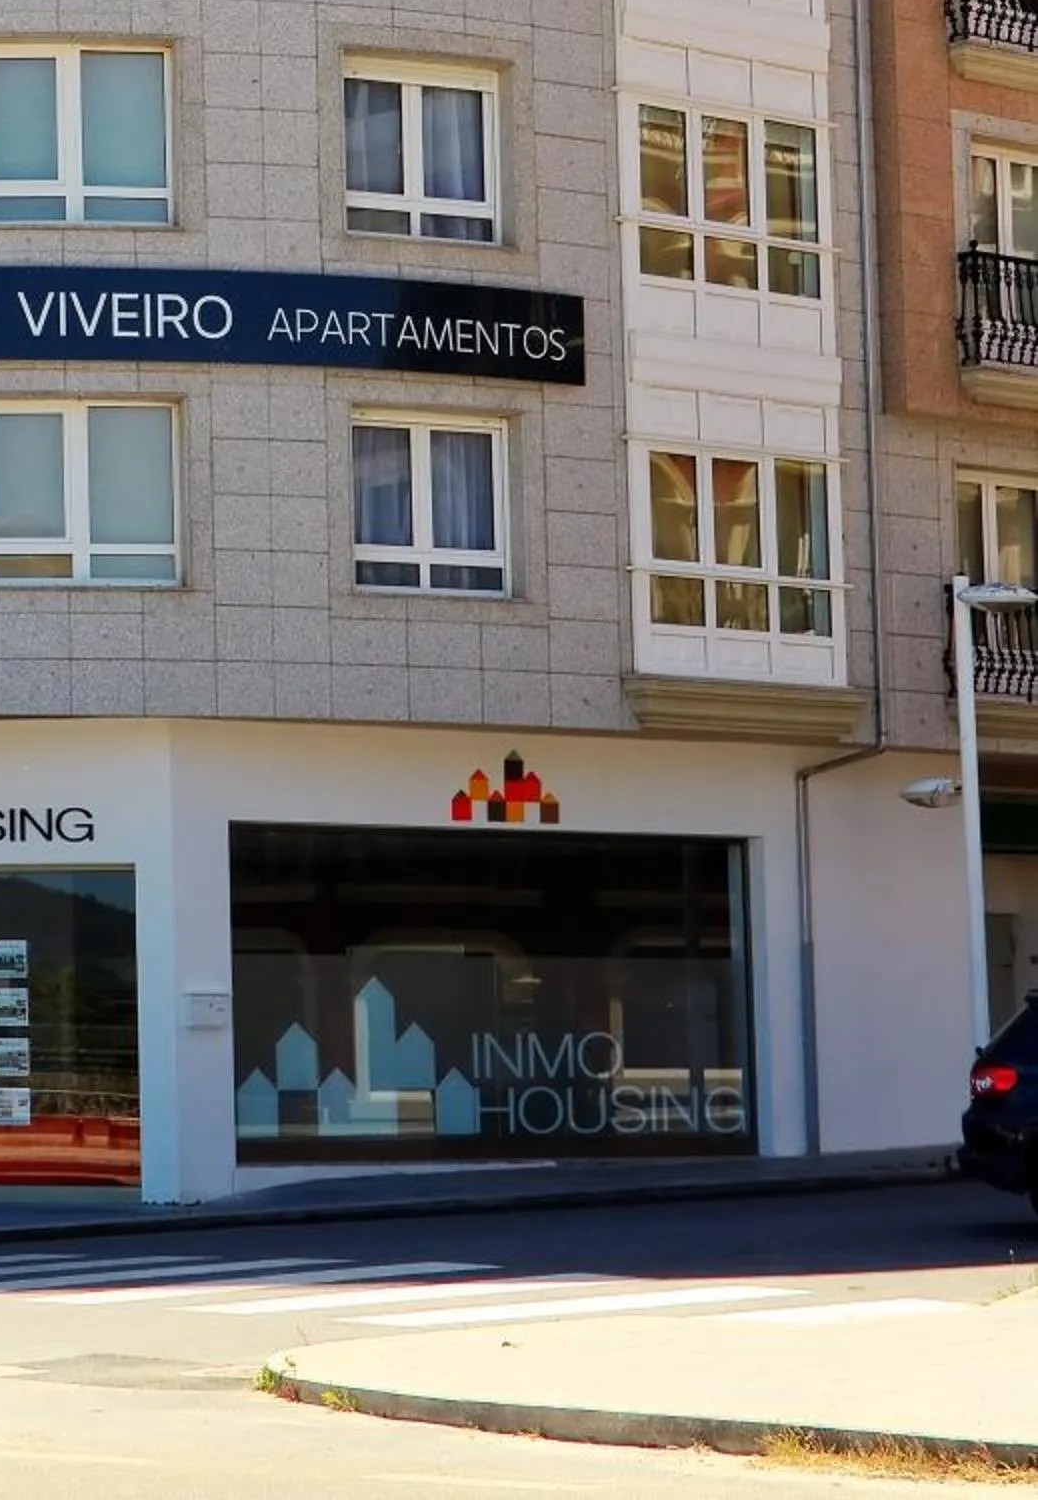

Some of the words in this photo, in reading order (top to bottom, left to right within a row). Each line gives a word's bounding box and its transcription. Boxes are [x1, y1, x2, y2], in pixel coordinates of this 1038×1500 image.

[17, 291, 233, 339] VIVEIRO
[267, 307, 567, 361] APARTAMENTOS
[472, 1031, 623, 1079] INMO
[476, 1086, 746, 1133] HOUSING
